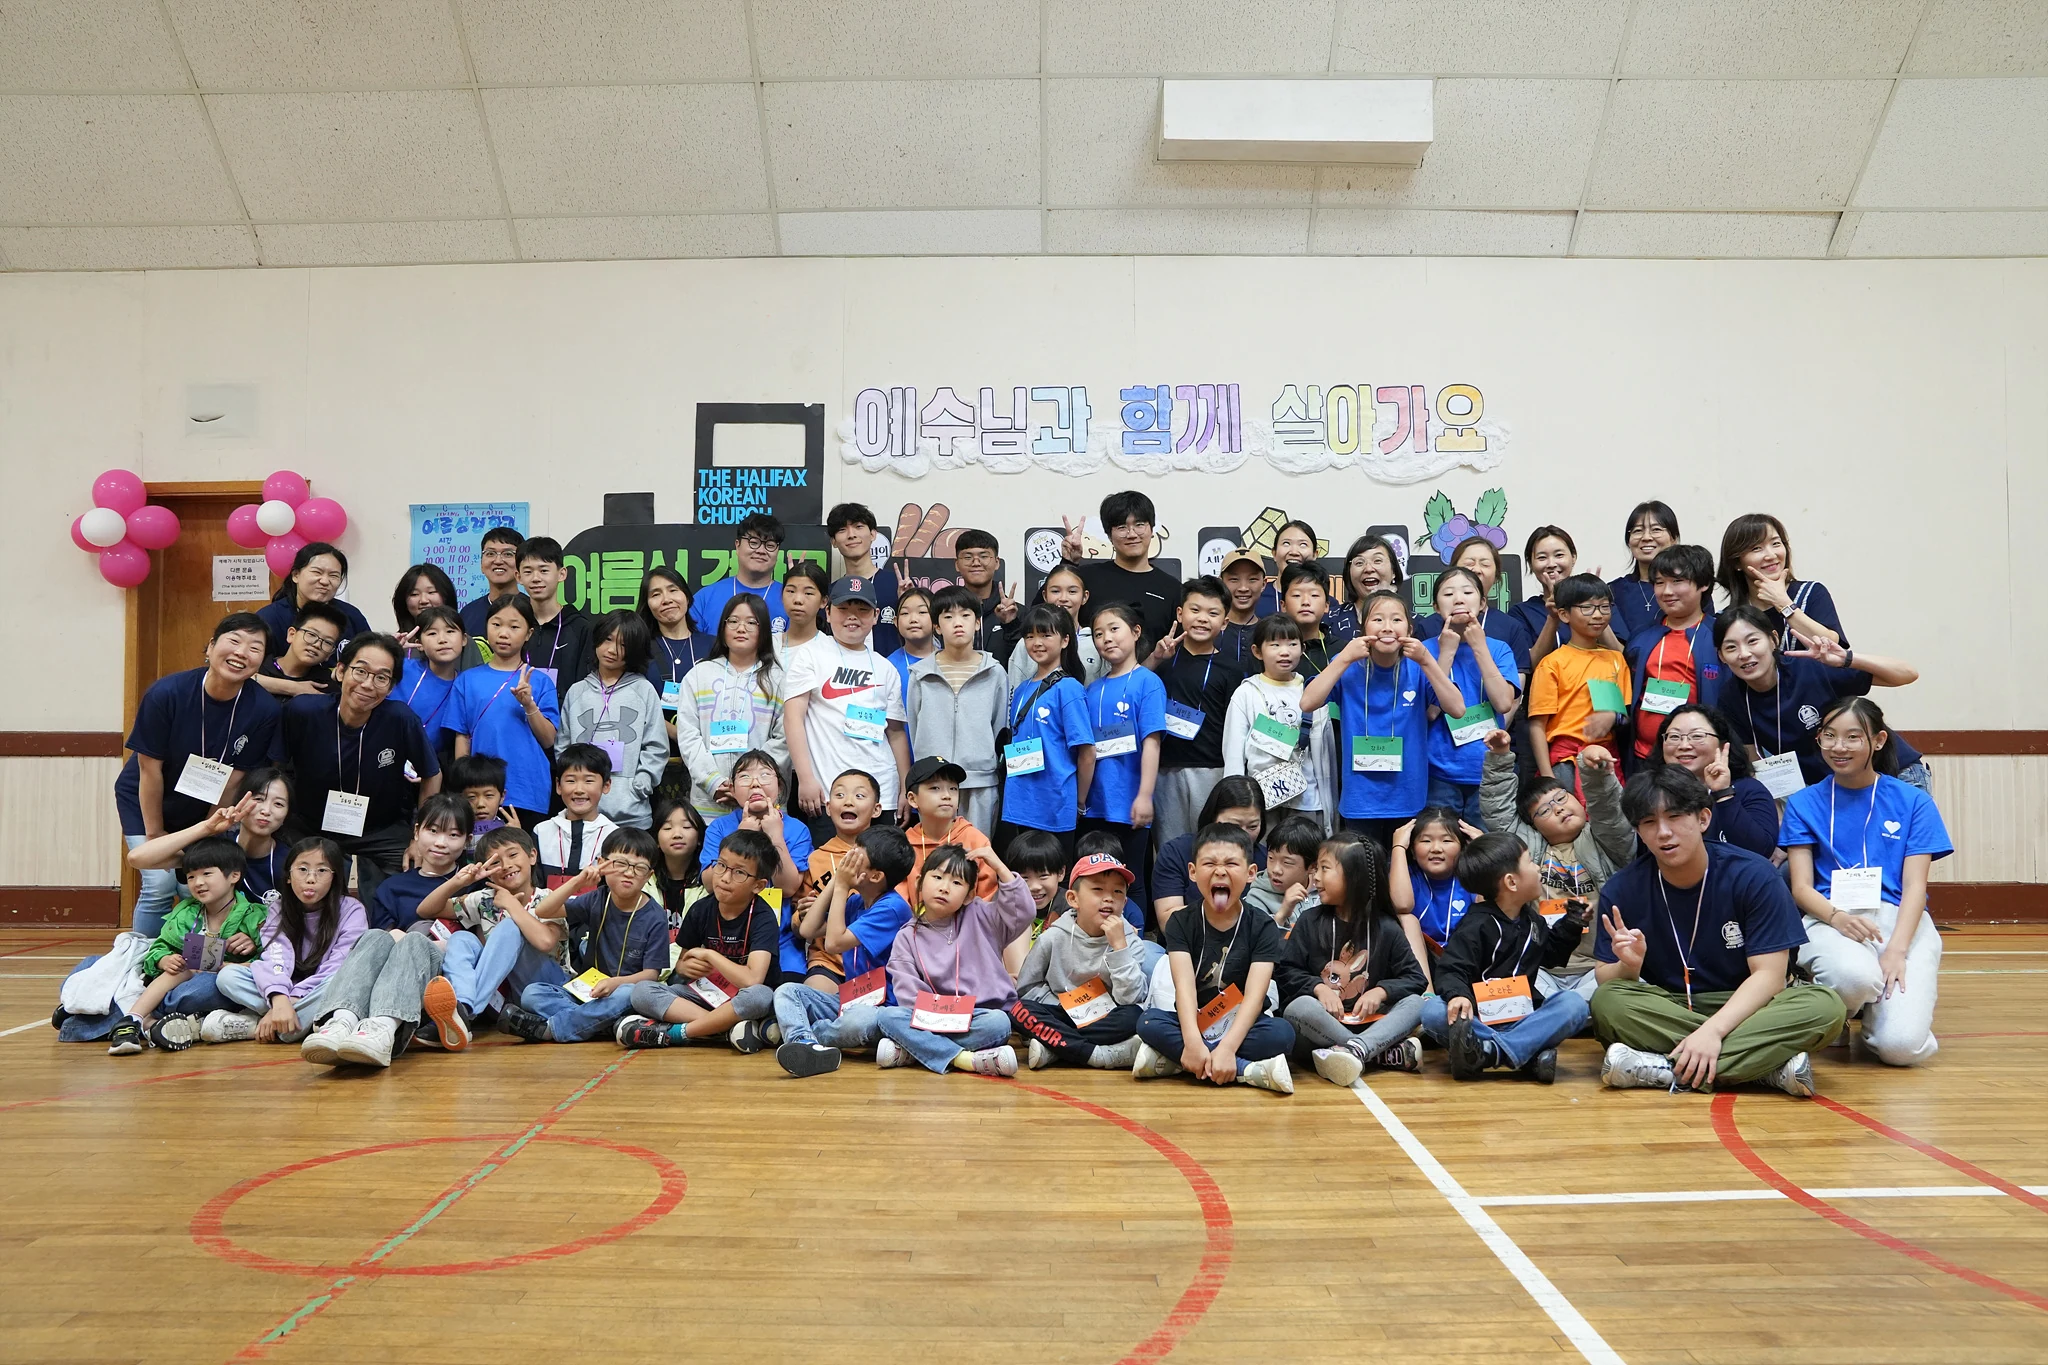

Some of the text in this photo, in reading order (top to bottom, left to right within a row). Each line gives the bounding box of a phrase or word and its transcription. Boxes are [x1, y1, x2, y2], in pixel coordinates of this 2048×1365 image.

[854, 383, 1488, 457] 예수님과 함께 살아가요
[698, 469, 808, 487] THE HALIFAX
[698, 487, 767, 505] KOREAN
[832, 666, 874, 687] NIKE
